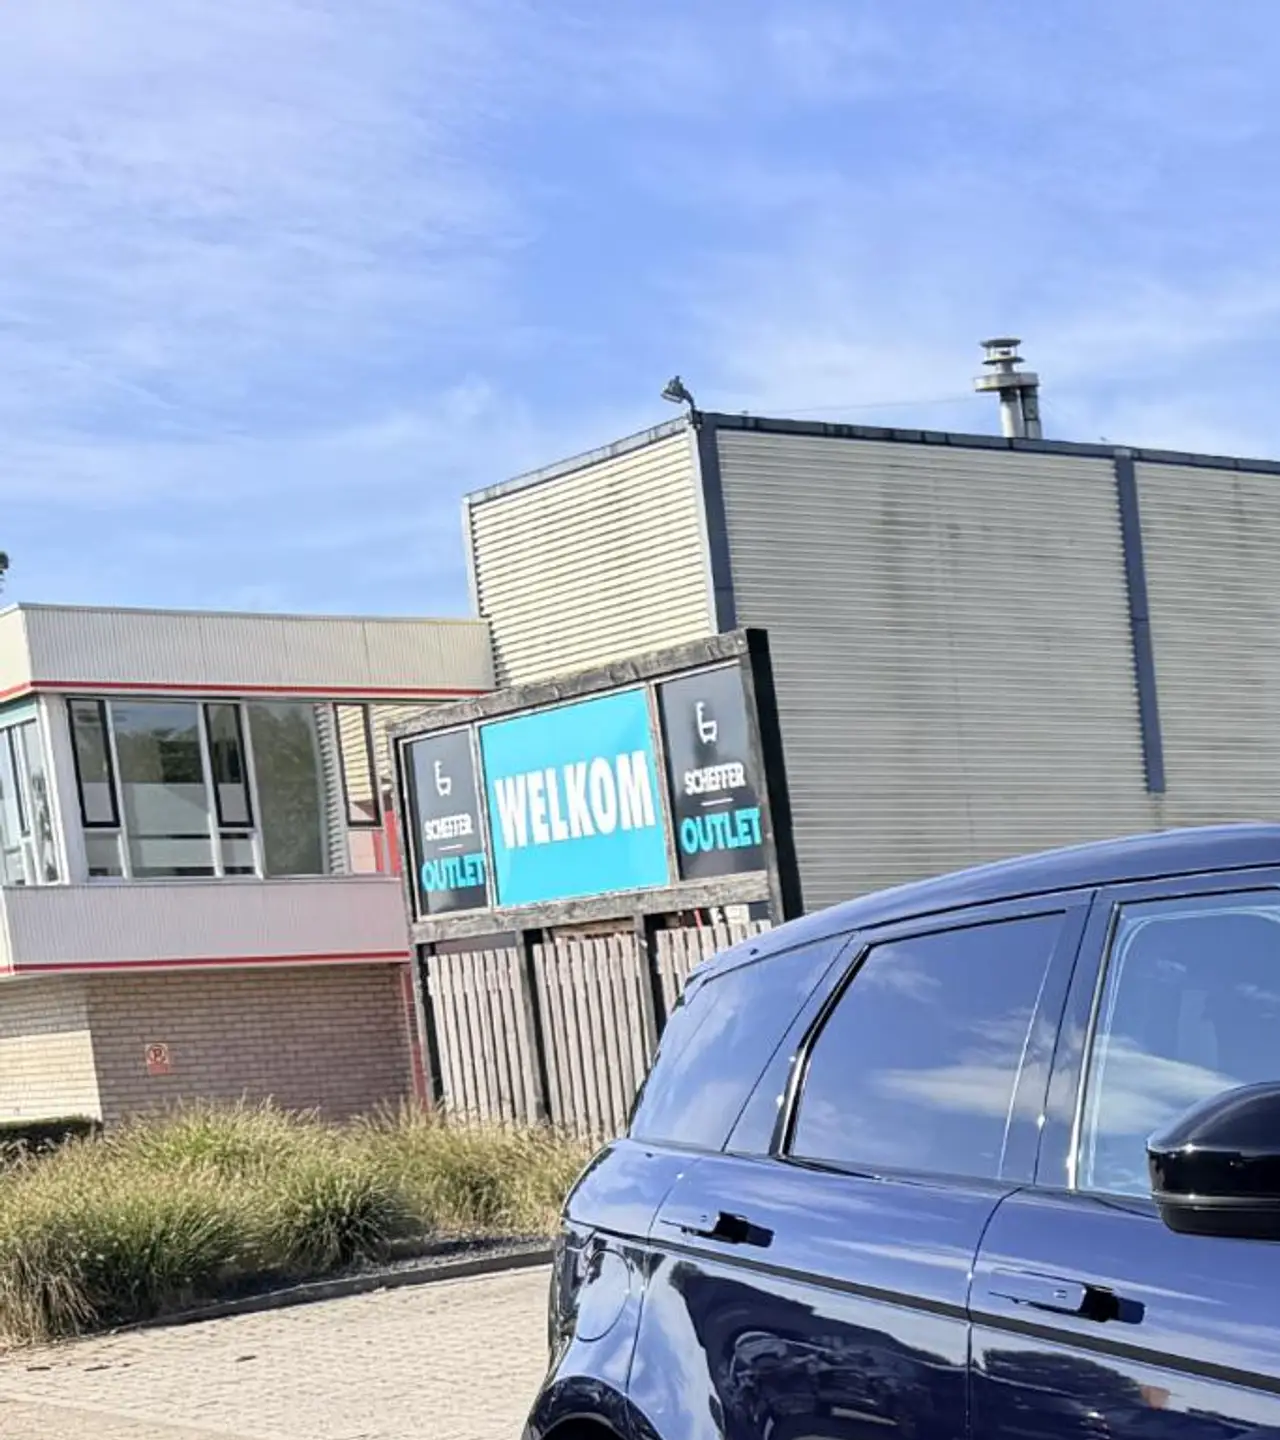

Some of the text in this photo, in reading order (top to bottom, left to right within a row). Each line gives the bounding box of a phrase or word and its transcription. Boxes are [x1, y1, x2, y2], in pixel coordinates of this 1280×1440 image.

[495, 751, 655, 848] WELKOM
[681, 807, 762, 855] OUTLET
[421, 852, 486, 892] OUTLET
